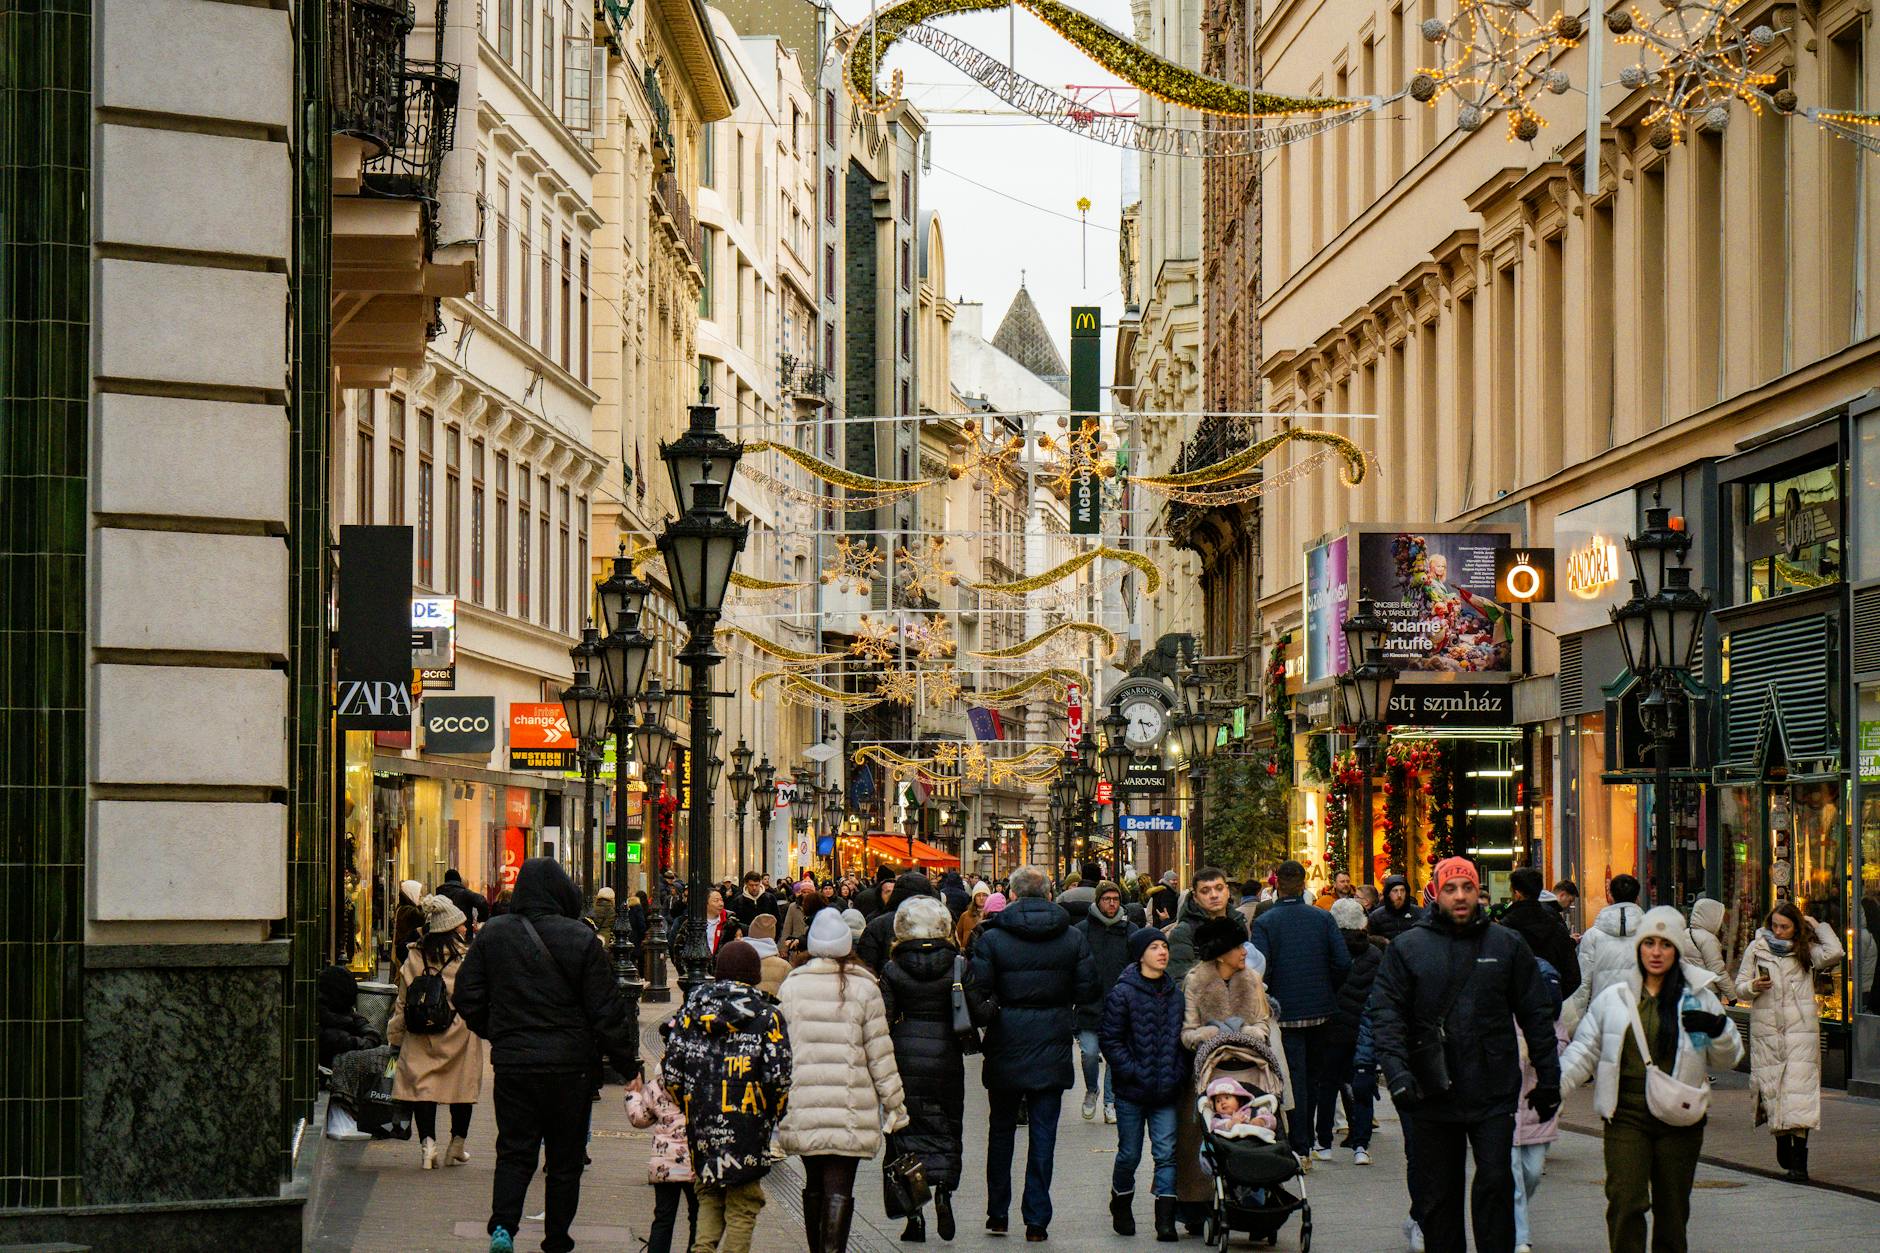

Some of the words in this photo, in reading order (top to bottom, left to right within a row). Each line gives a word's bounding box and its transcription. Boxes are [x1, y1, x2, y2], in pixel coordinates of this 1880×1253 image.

[1567, 546, 1609, 592] PANDORA
[1388, 619, 1441, 632] adame
[1384, 637, 1432, 650] artuffe
[422, 670, 450, 678] ecret
[338, 681, 411, 716] ZARA
[1121, 687, 1162, 699] SWAROVSKI
[430, 717, 489, 732] ecco
[514, 715, 555, 727] change
[512, 752, 561, 760] WESTERN
[682, 750, 690, 784] Locker
[1127, 817, 1173, 830] Berlitz
[724, 1055, 752, 1079] THE
